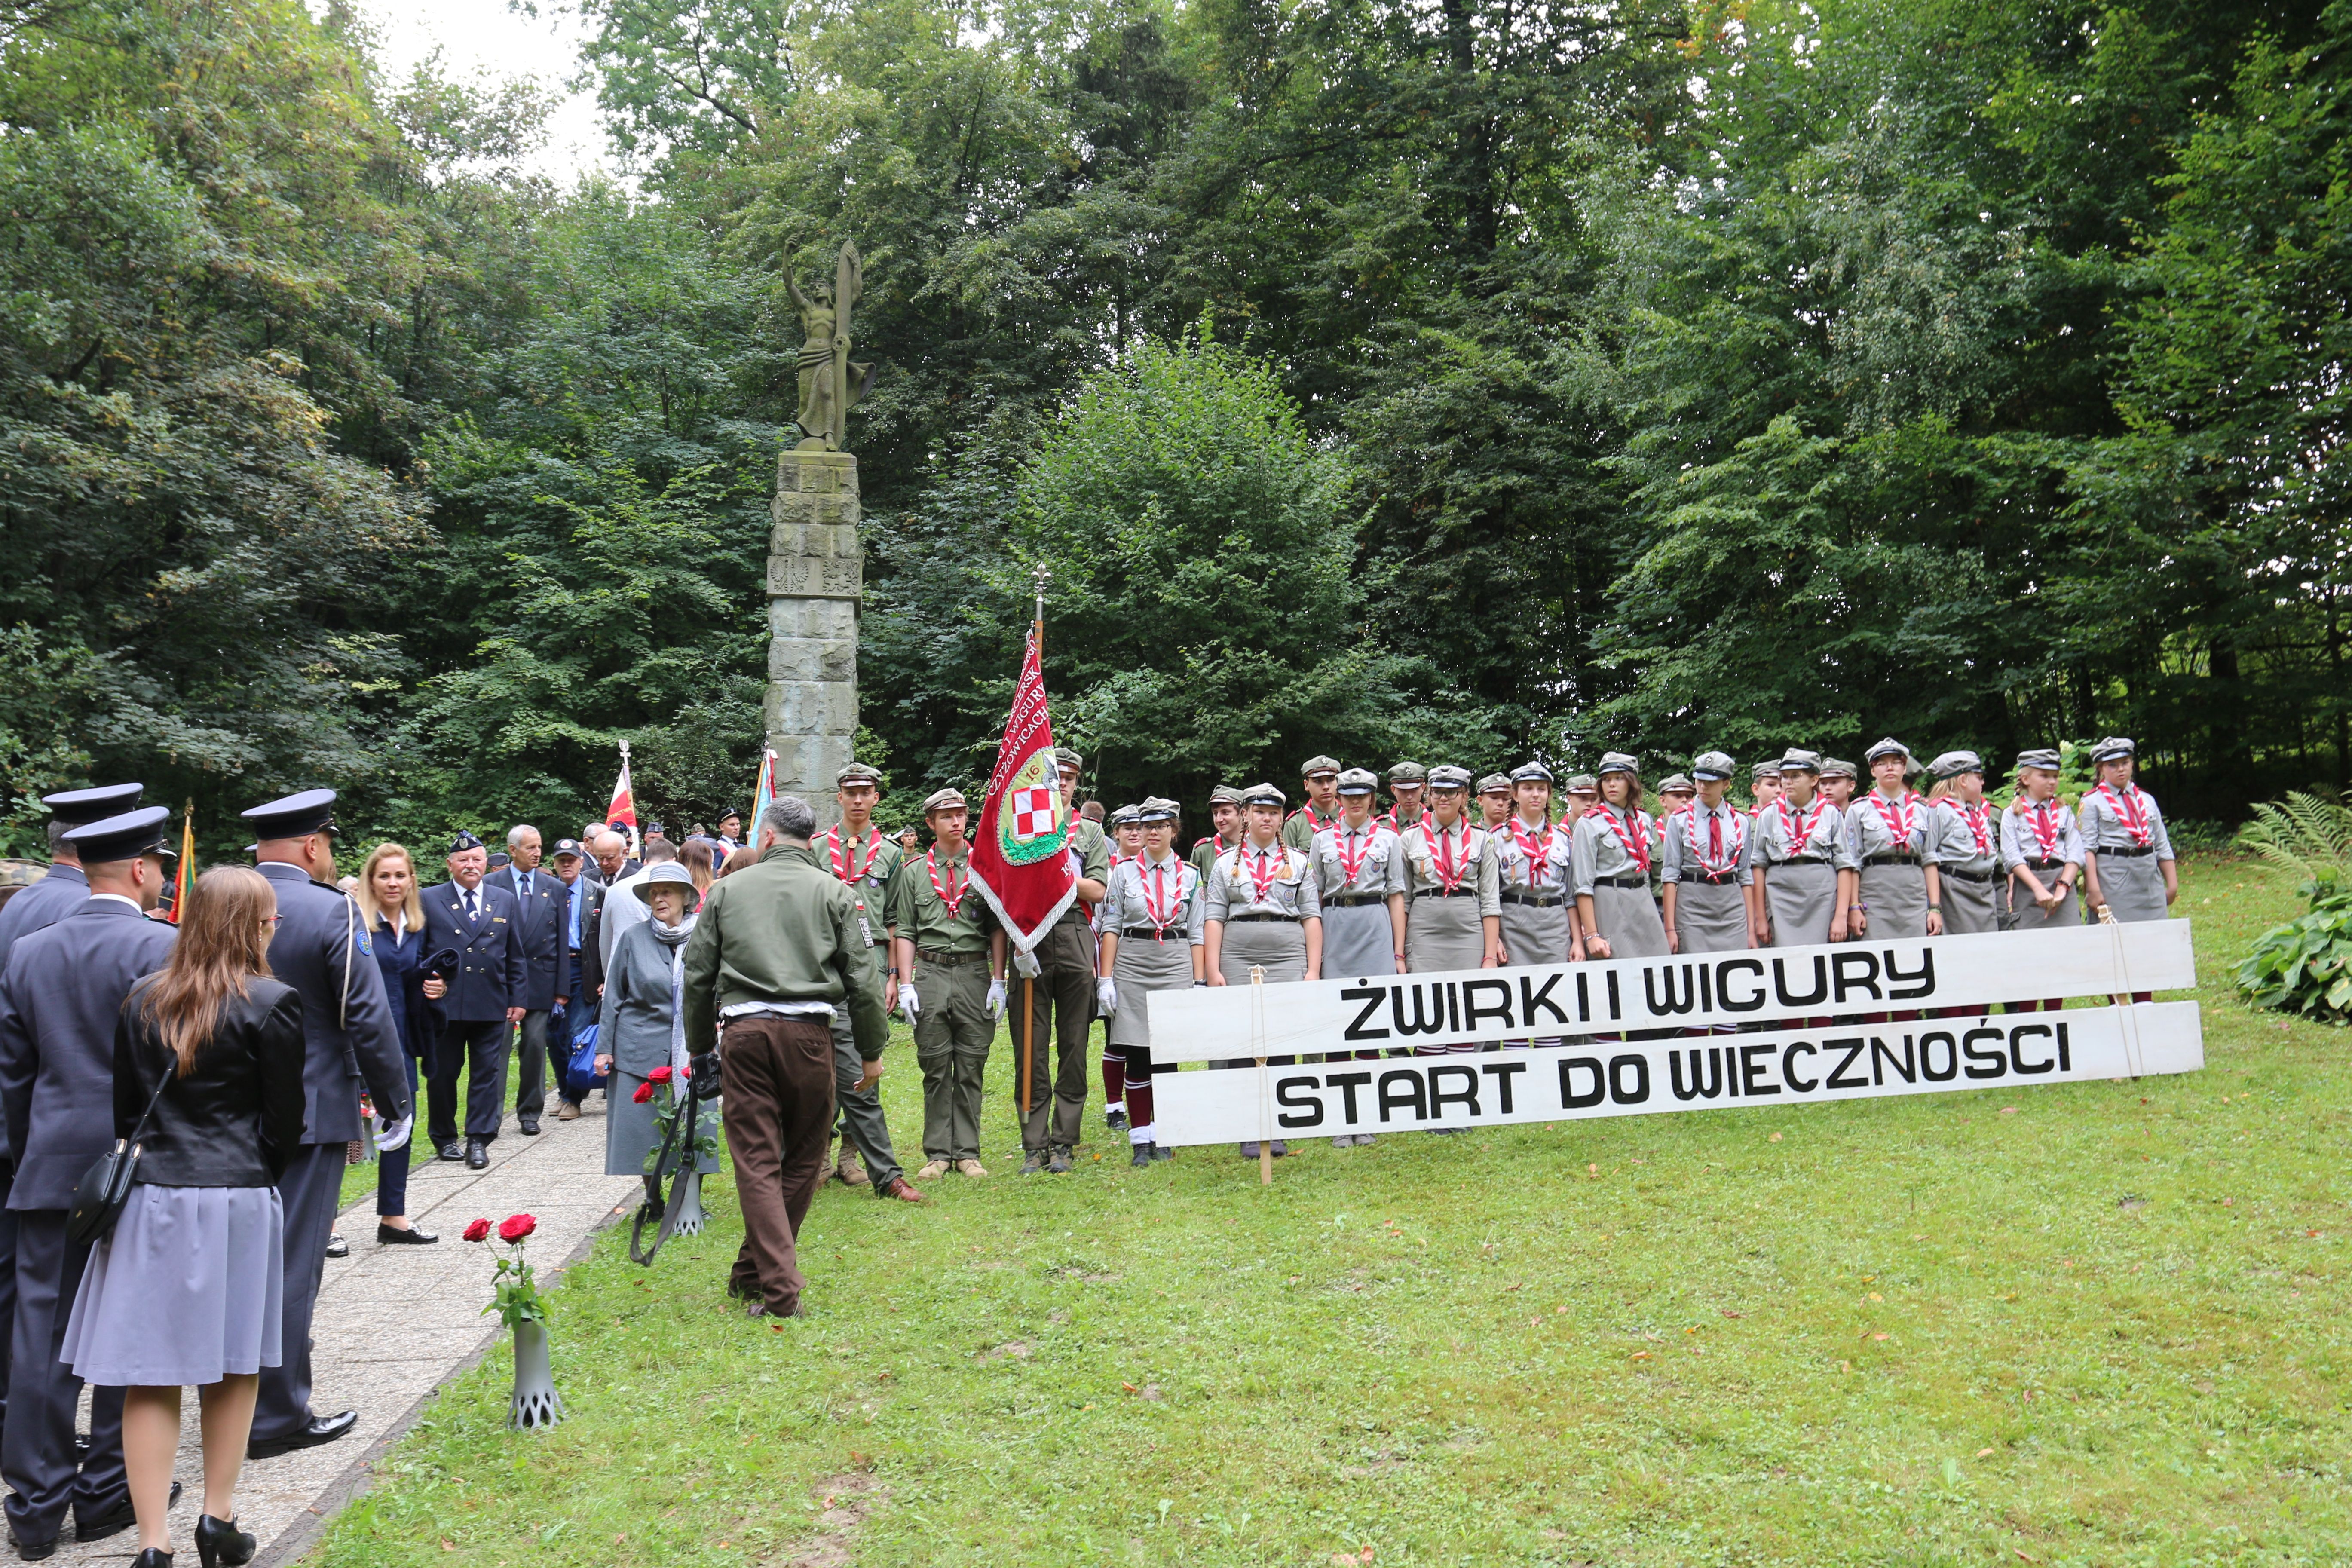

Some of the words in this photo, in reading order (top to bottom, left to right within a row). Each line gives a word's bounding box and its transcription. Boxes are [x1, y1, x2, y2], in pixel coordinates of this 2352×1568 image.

[988, 705, 1049, 796] CZYŻOWICACH
[1026, 765, 1040, 781] 16
[606, 806, 632, 823] OTNICTWA
[1341, 978, 1591, 1041] ŻWIRKI
[1606, 970, 1622, 1020] I
[1643, 947, 1936, 1016] WIGURY
[1276, 1062, 1526, 1128] START
[1558, 1054, 1650, 1109] DO
[1669, 1018, 2071, 1101] WIECZNOŚCI
